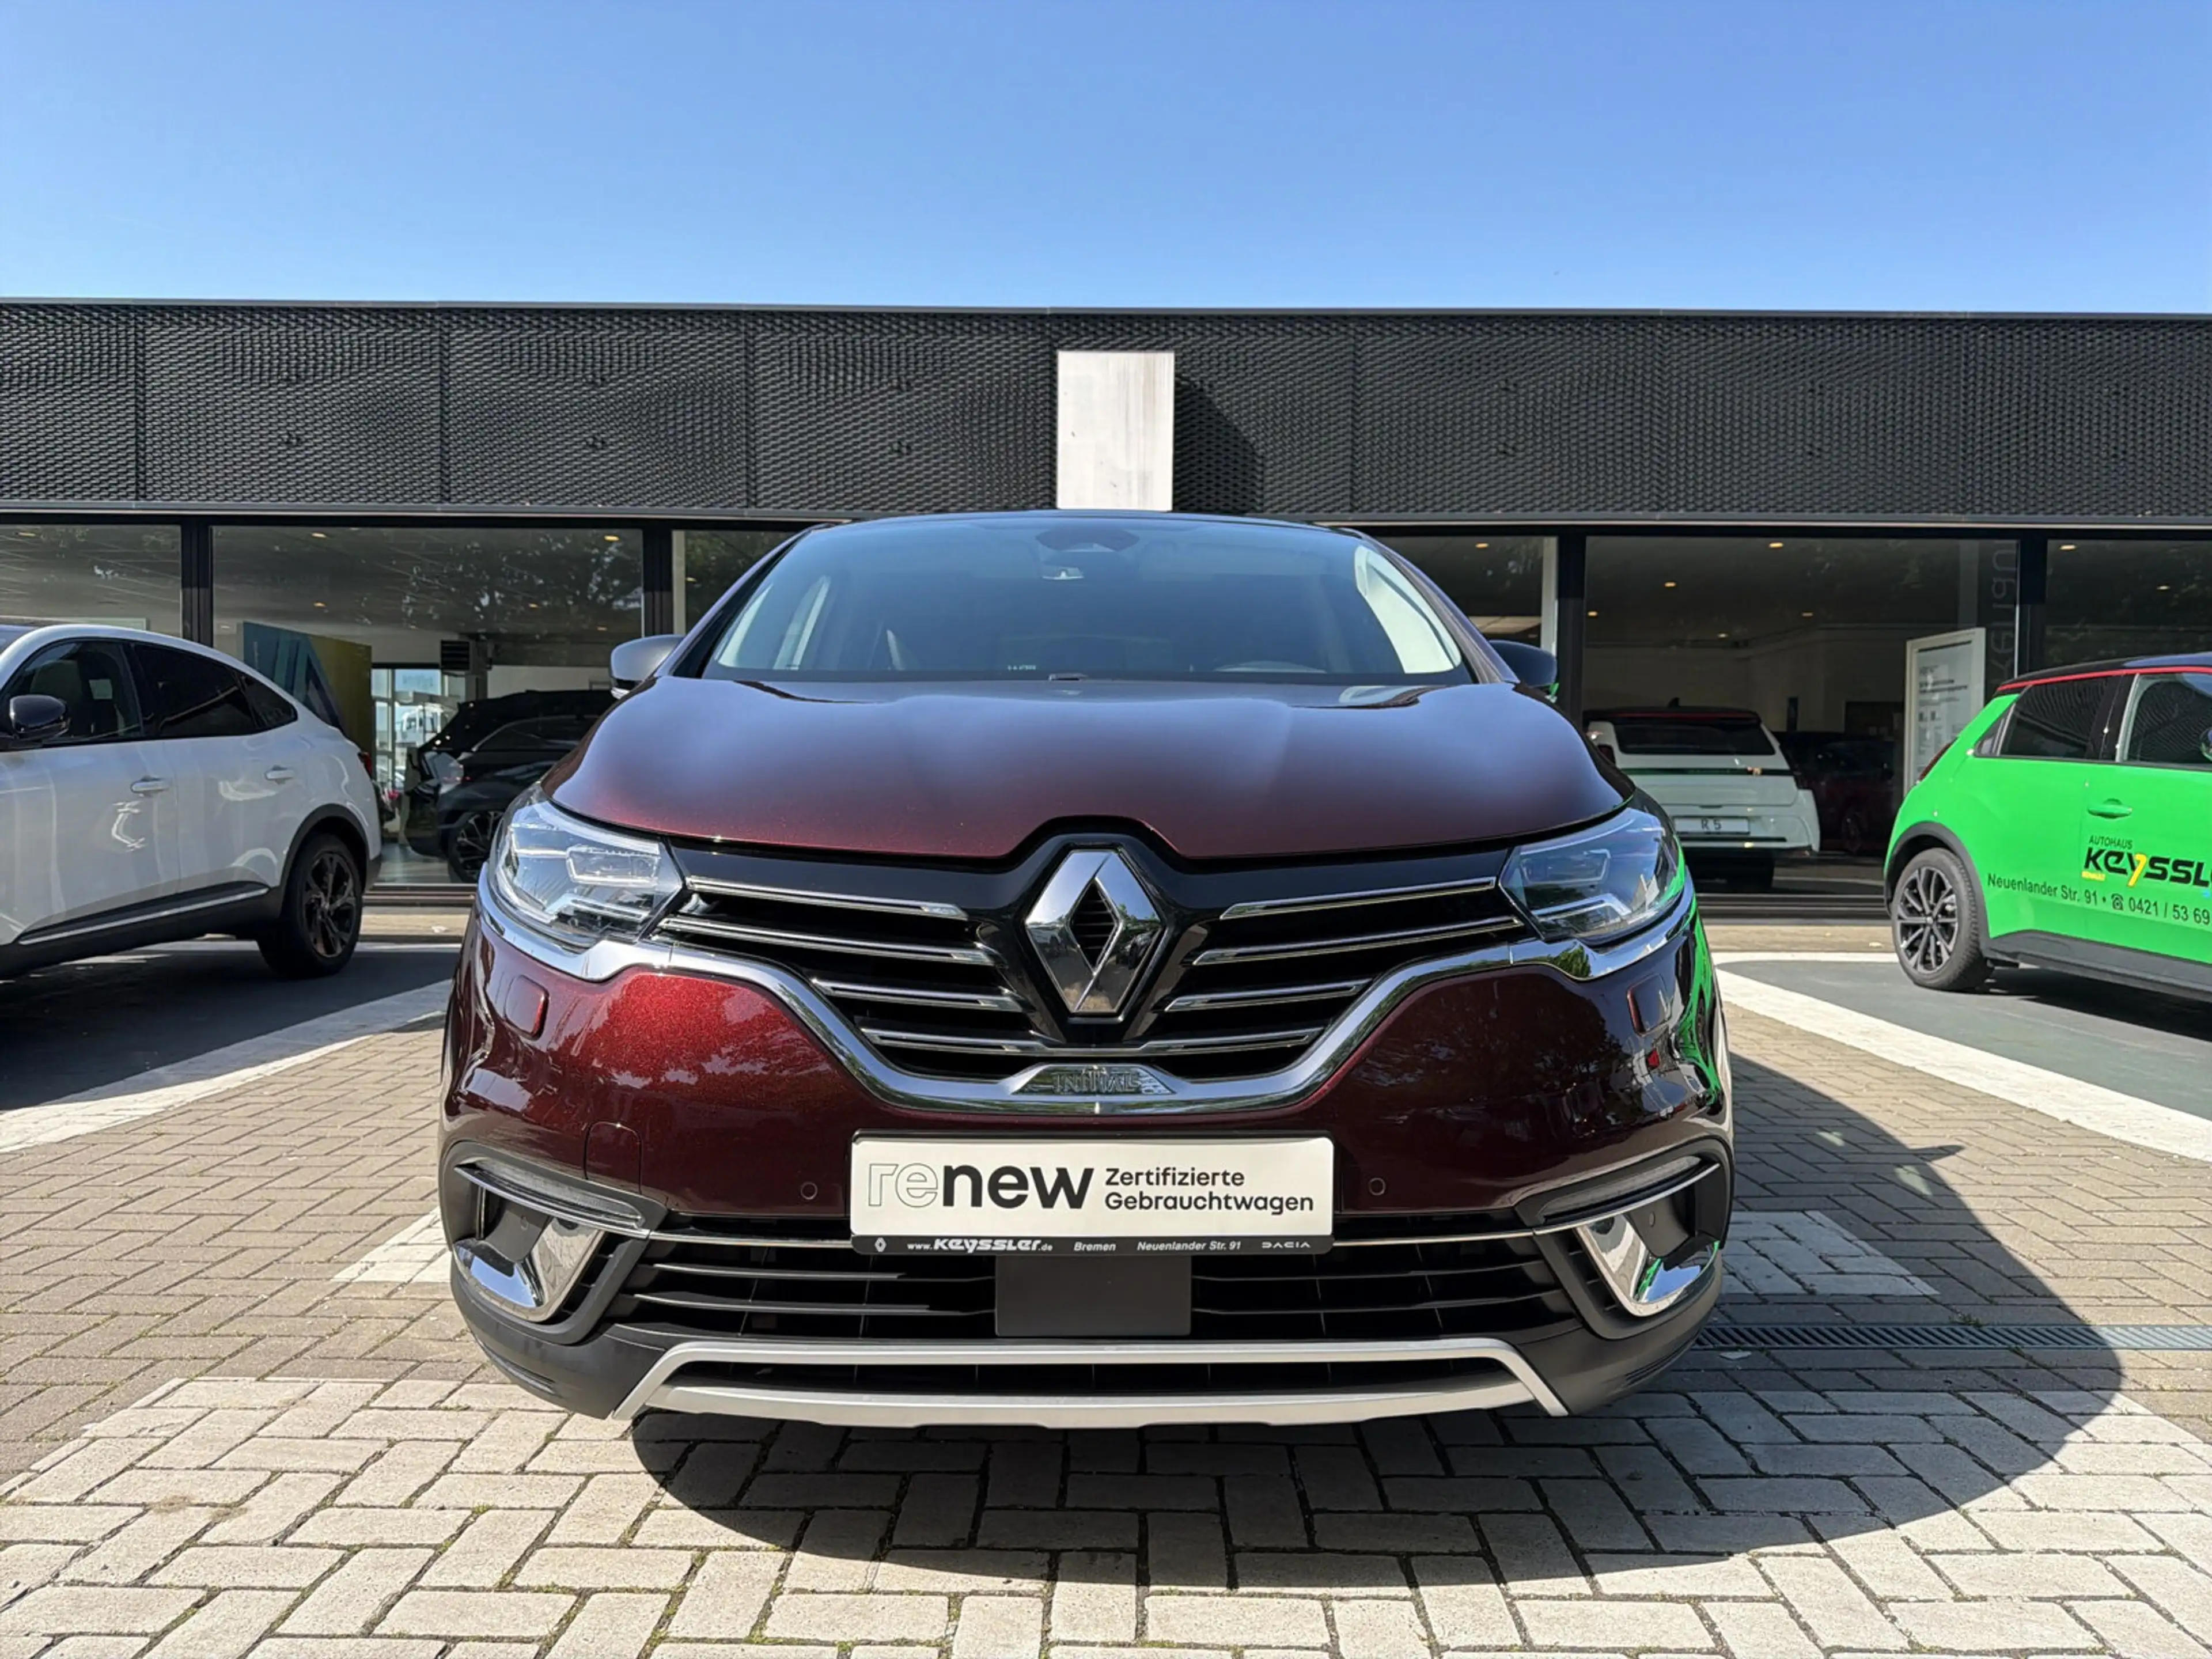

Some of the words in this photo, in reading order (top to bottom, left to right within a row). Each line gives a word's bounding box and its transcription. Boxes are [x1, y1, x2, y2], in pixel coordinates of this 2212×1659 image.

[2089, 835, 2133, 850] AUTOHAUS
[1988, 873, 2058, 897] Neuenlander
[2061, 885, 2080, 902] Str.
[2084, 889, 2097, 906] 91
[2128, 897, 2158, 916] 0421
[2172, 904, 2189, 921] 53
[2193, 907, 2210, 925] 69
[868, 1162, 1094, 1209] renew
[1105, 1167, 1245, 1187] Zertifizierte
[1105, 1191, 1313, 1215] Gebrauchtwagen
[1074, 1241, 1116, 1251] Bremen
[1137, 1241, 1207, 1251] Neuenlander
[1209, 1241, 1226, 1251] Str.
[1229, 1241, 1241, 1250] 91
